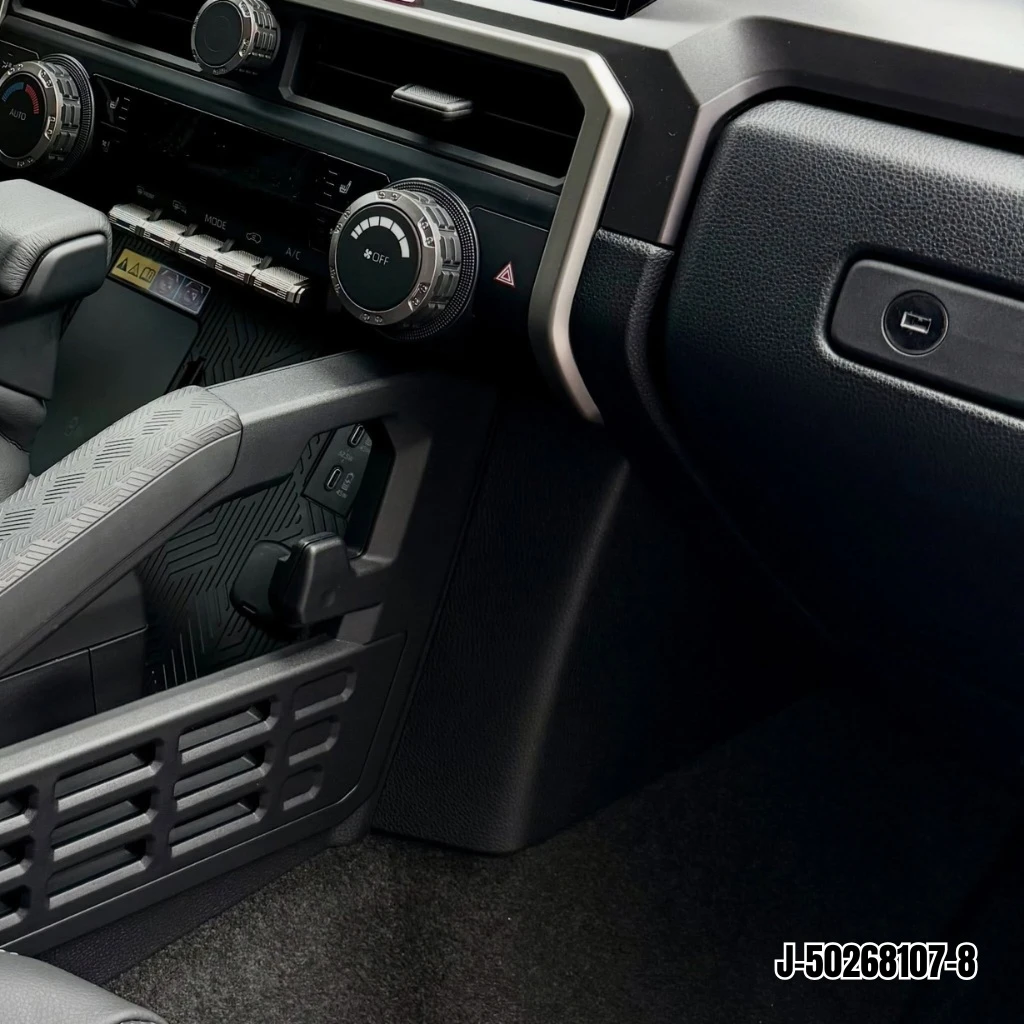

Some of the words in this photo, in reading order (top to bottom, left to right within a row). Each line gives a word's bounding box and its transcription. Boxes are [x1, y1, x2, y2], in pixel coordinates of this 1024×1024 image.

[8, 108, 26, 121] AUTO
[204, 214, 226, 231] MODE
[285, 247, 300, 261] A/C
[372, 252, 390, 266] OFF
